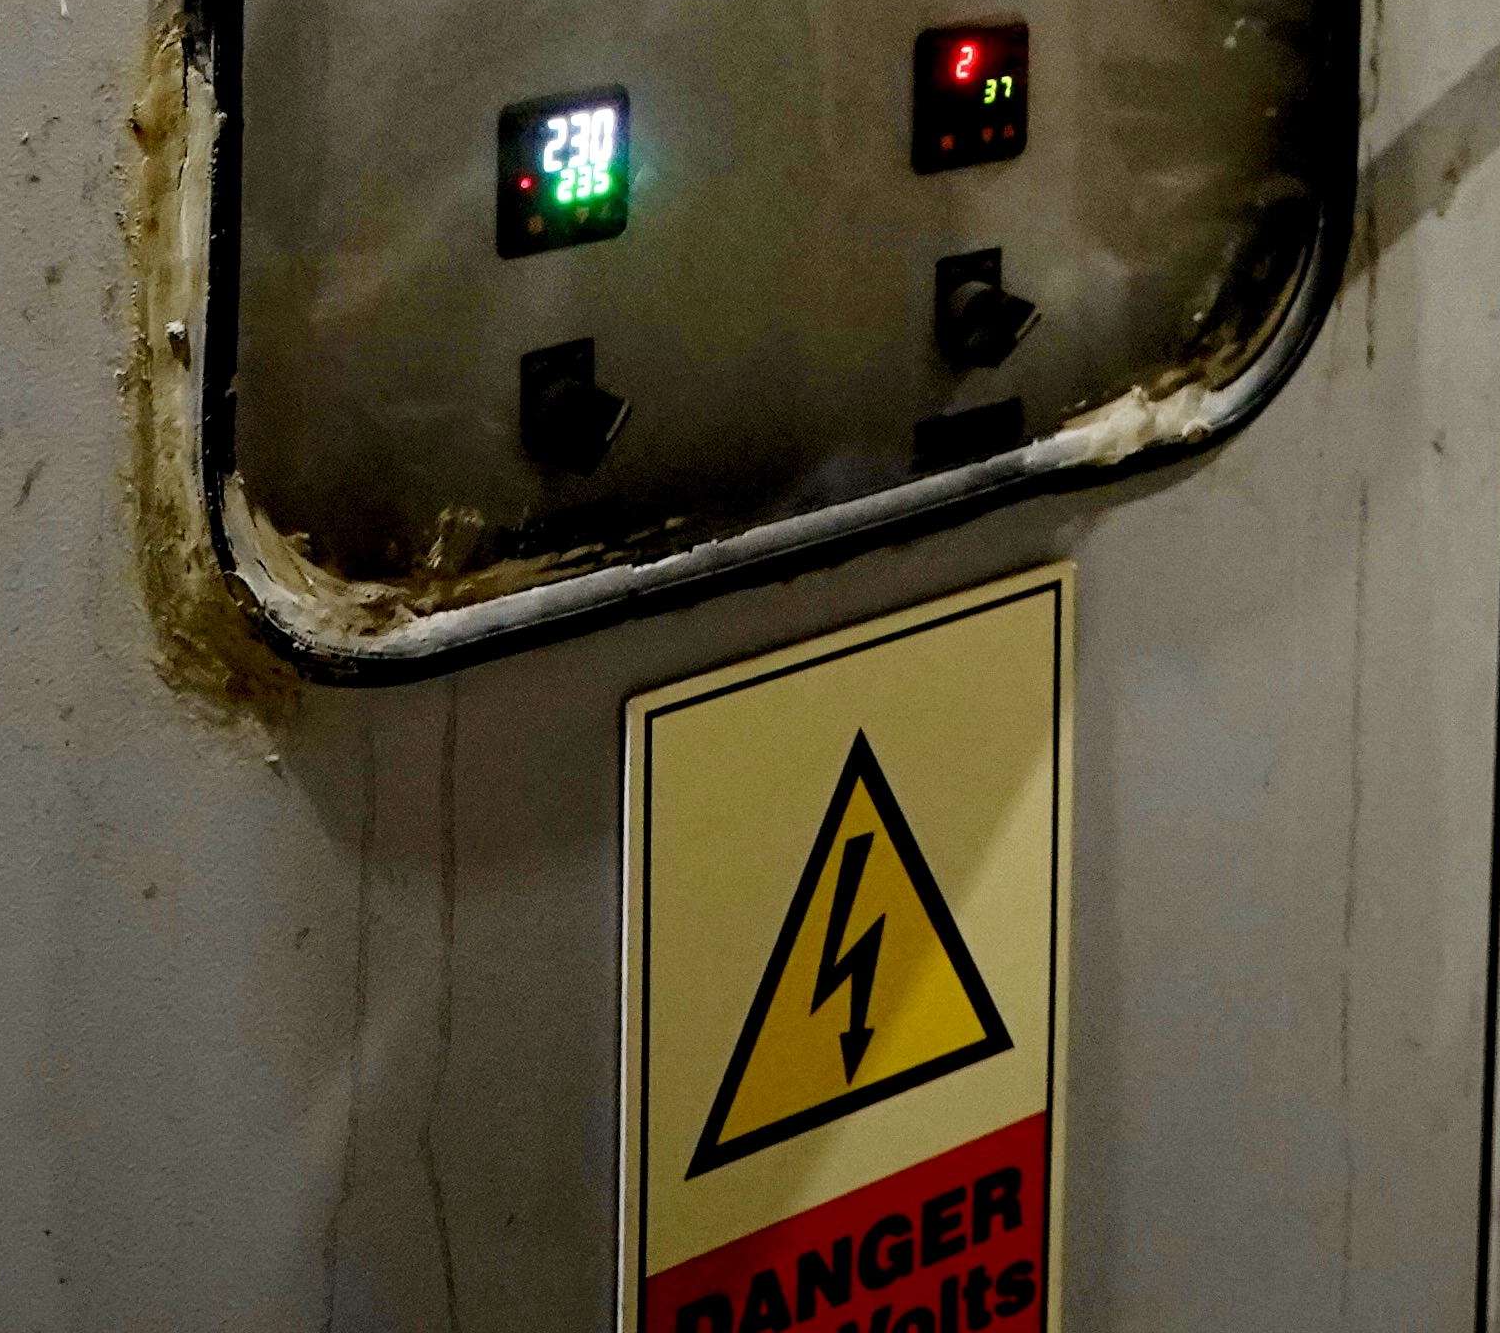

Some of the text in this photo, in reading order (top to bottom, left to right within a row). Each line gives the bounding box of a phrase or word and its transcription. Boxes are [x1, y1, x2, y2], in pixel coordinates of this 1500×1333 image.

[955, 45, 974, 80] 2
[543, 108, 615, 172] 230
[556, 163, 610, 202] 235
